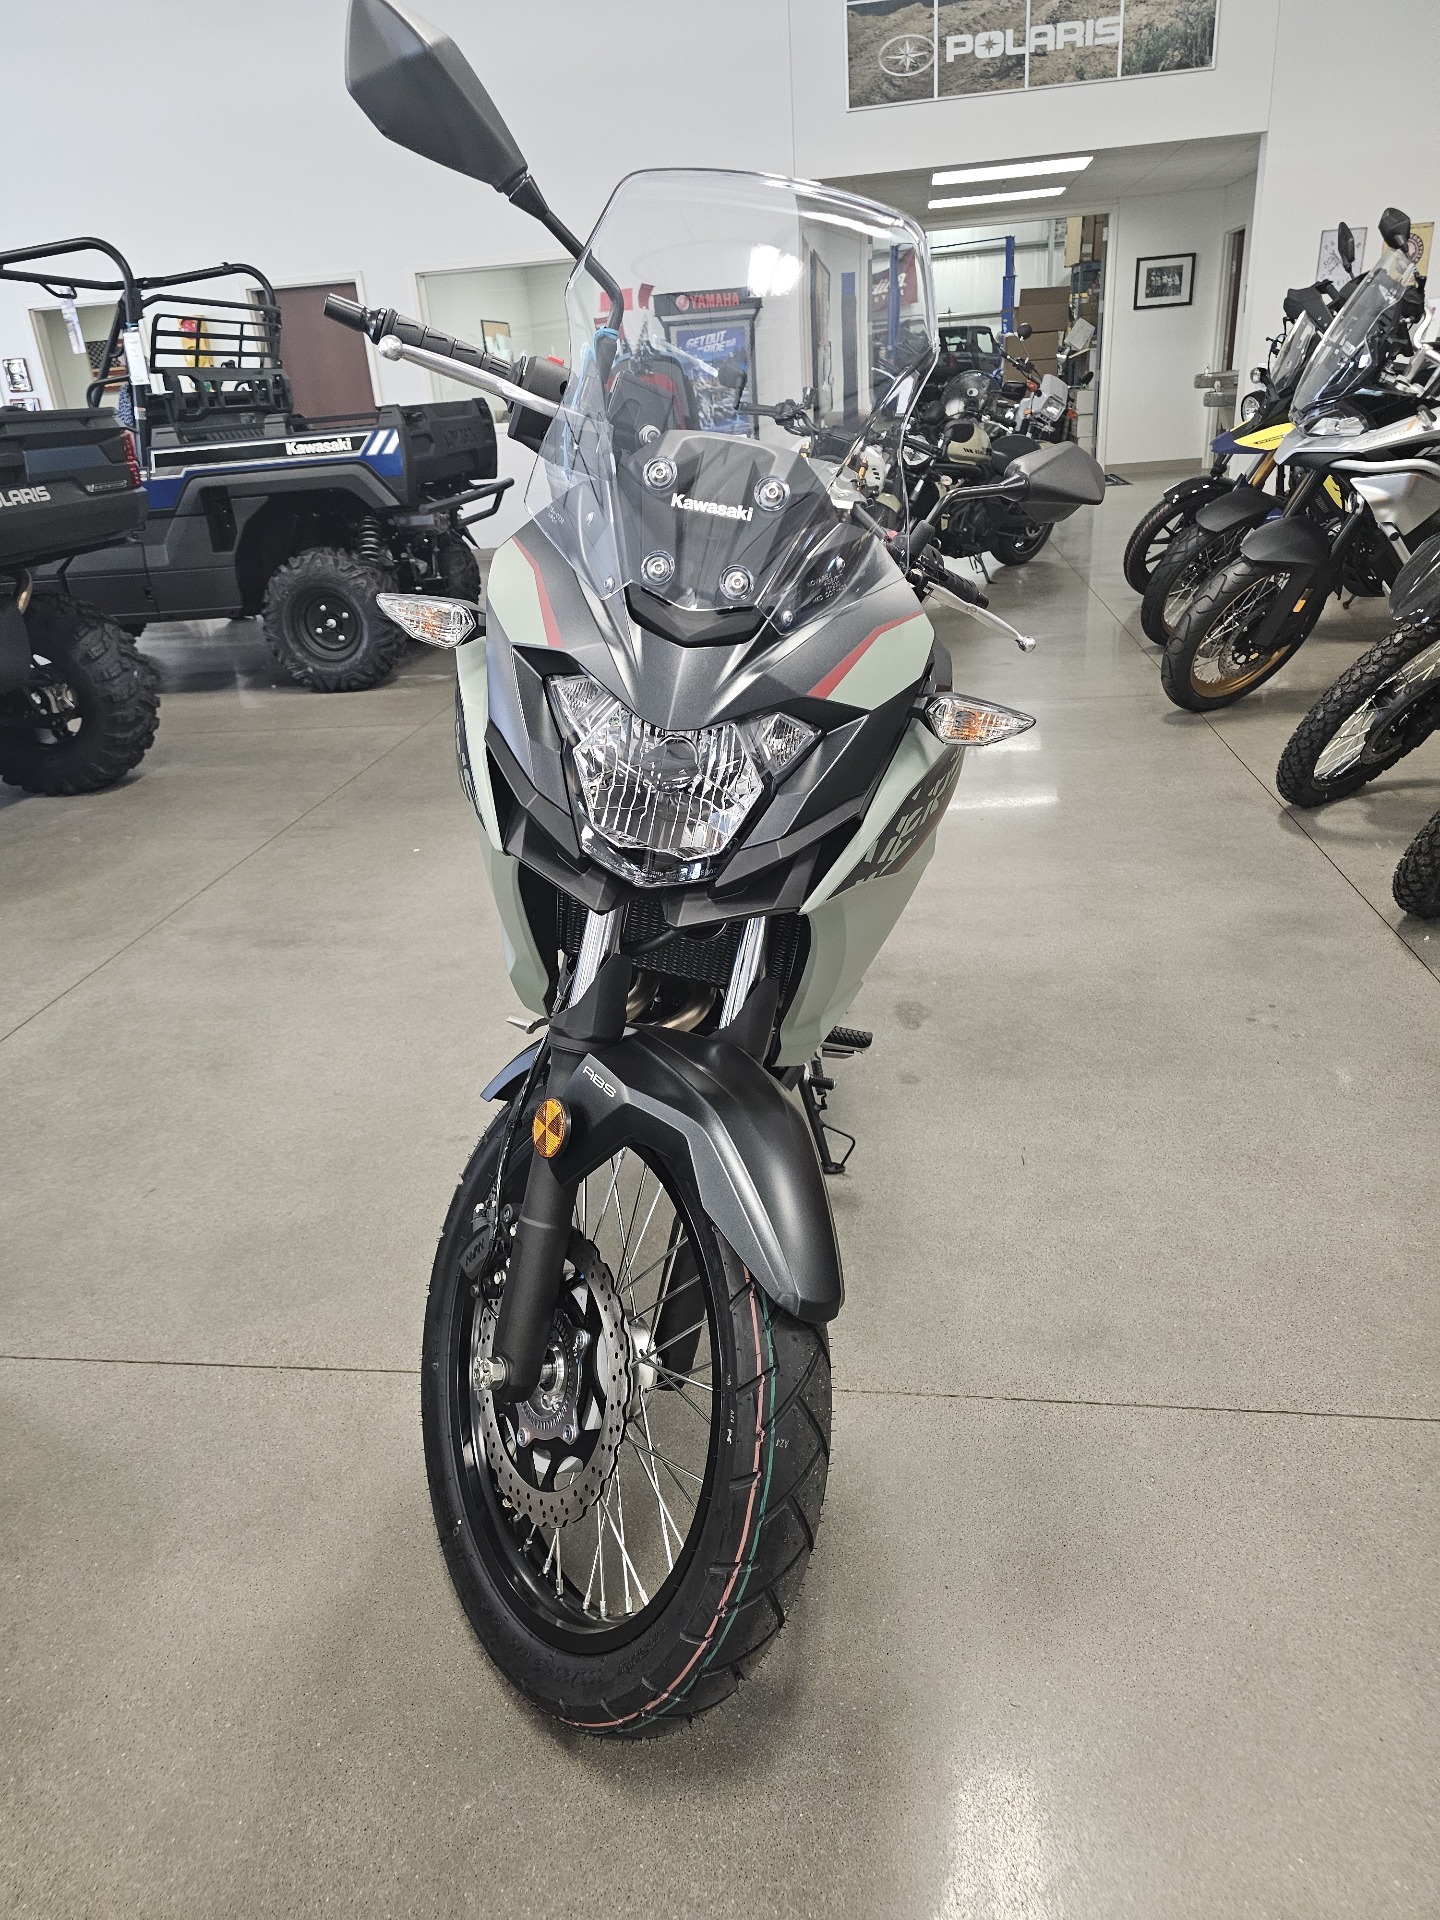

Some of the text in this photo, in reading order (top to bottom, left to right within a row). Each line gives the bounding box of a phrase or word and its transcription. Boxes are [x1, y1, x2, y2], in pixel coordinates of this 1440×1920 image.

[946, 16, 1121, 63] POLARIS
[690, 291, 740, 309] YAMAHA
[284, 437, 353, 456] Kawasaki
[0, 485, 52, 508] LARIS
[671, 492, 754, 522] Kawasaki
[582, 1065, 617, 1098] ABS
